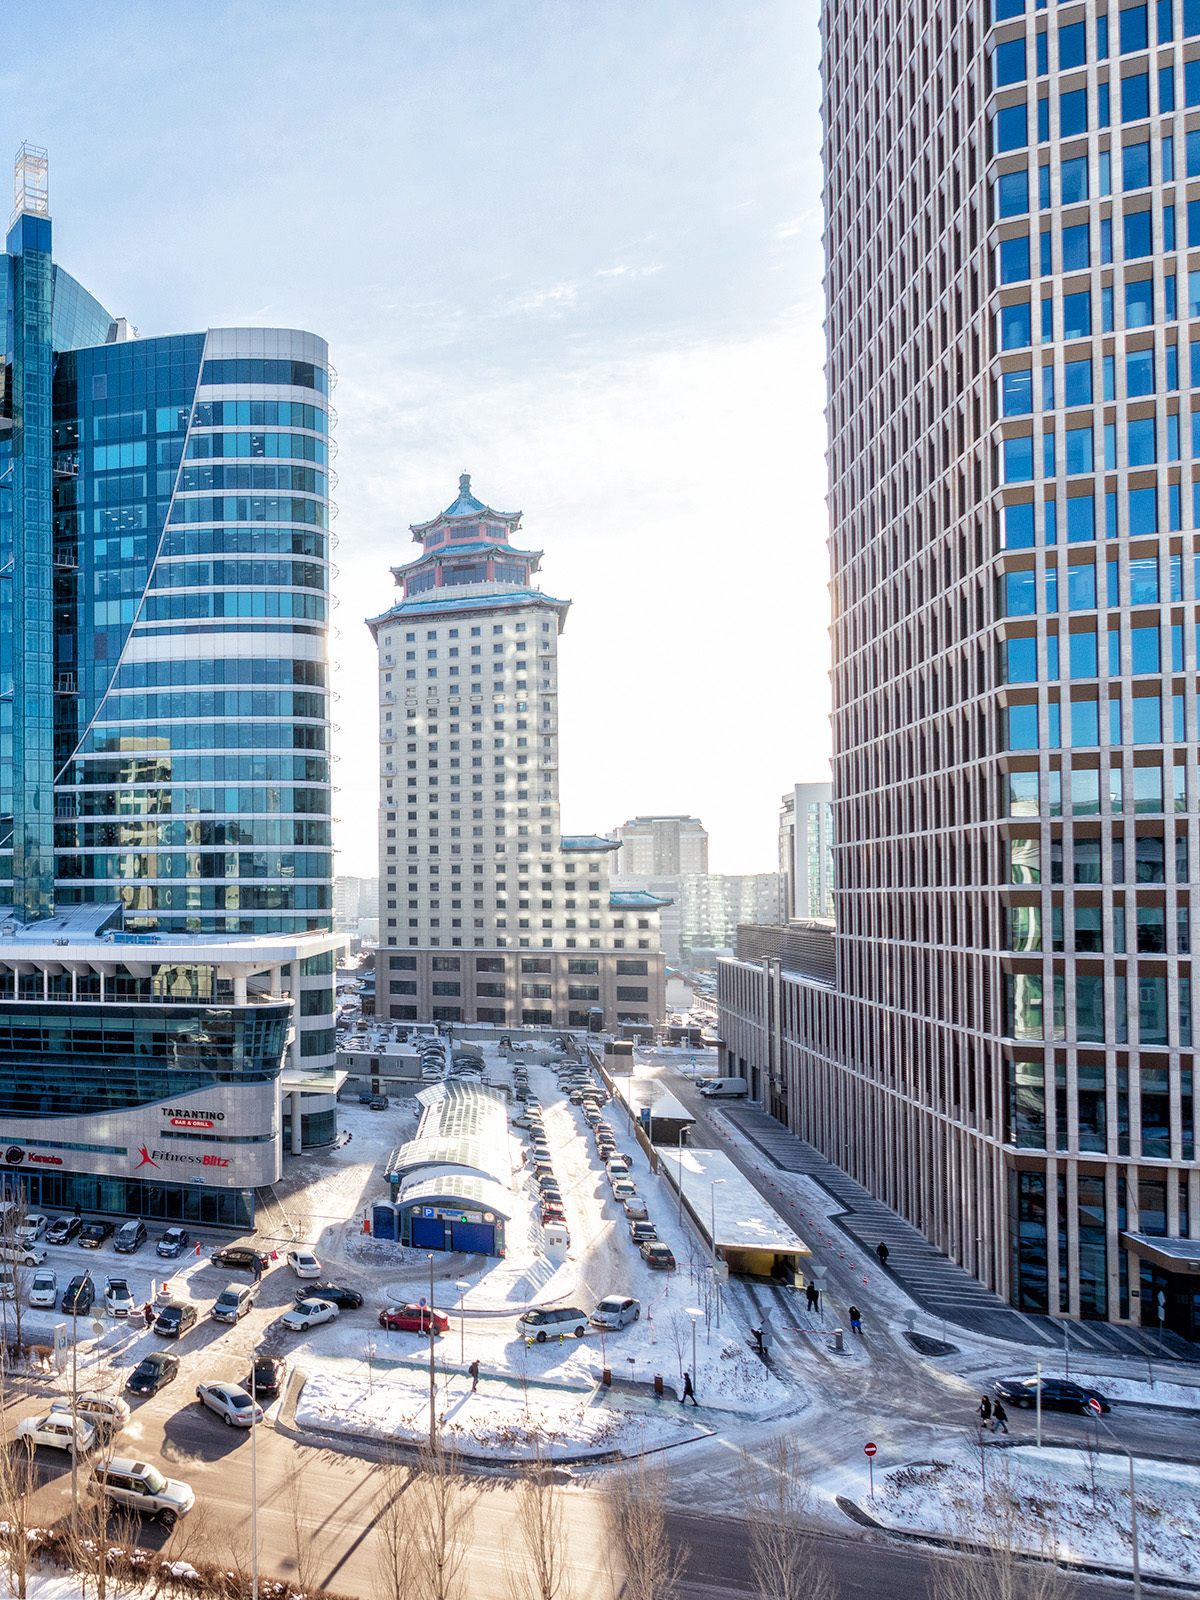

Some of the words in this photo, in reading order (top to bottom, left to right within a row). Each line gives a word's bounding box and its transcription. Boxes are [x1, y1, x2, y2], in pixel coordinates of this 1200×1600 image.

[161, 1107, 225, 1120] TARANTINO
[28, 1152, 63, 1165] Karaoke
[425, 1208, 432, 1216] P
